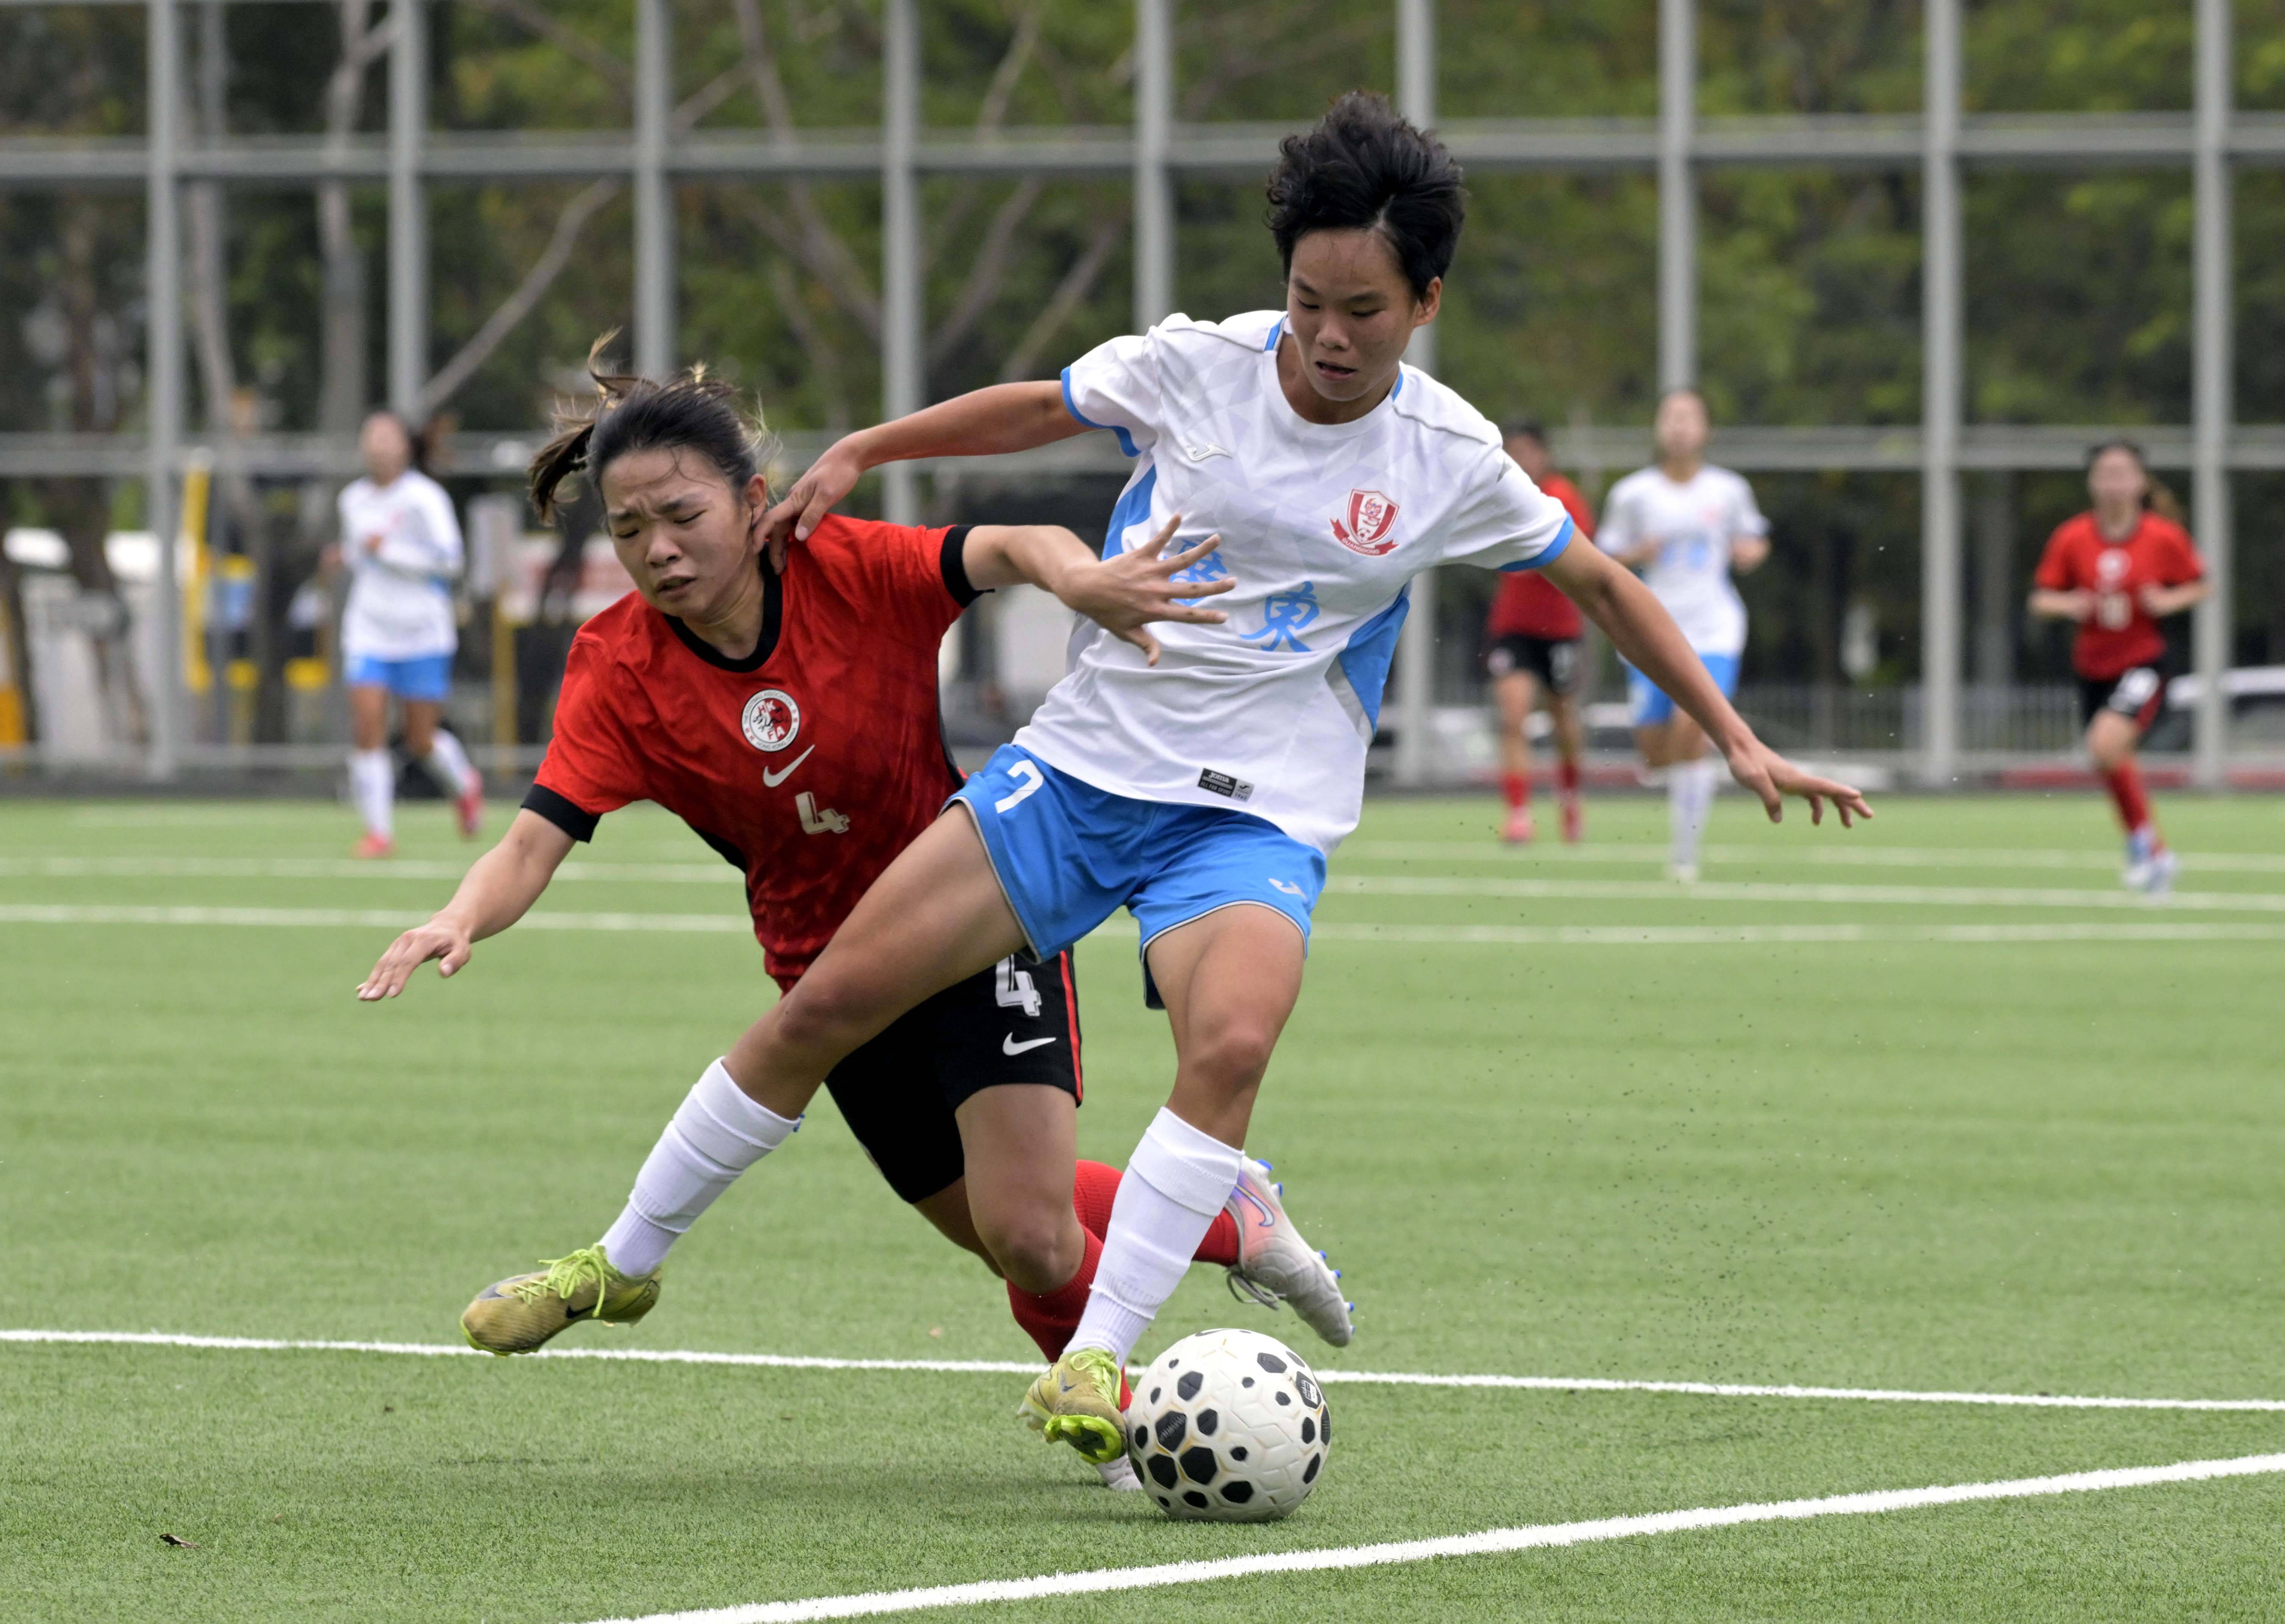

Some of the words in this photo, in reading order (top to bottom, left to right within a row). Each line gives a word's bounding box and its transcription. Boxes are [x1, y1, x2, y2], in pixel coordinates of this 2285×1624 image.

[1342, 538, 1380, 554] GUANGDONG
[994, 759, 1043, 814] 7
[1218, 787, 1231, 795] SPORT
[795, 791, 851, 835] 4
[995, 954, 1042, 1017] 4
